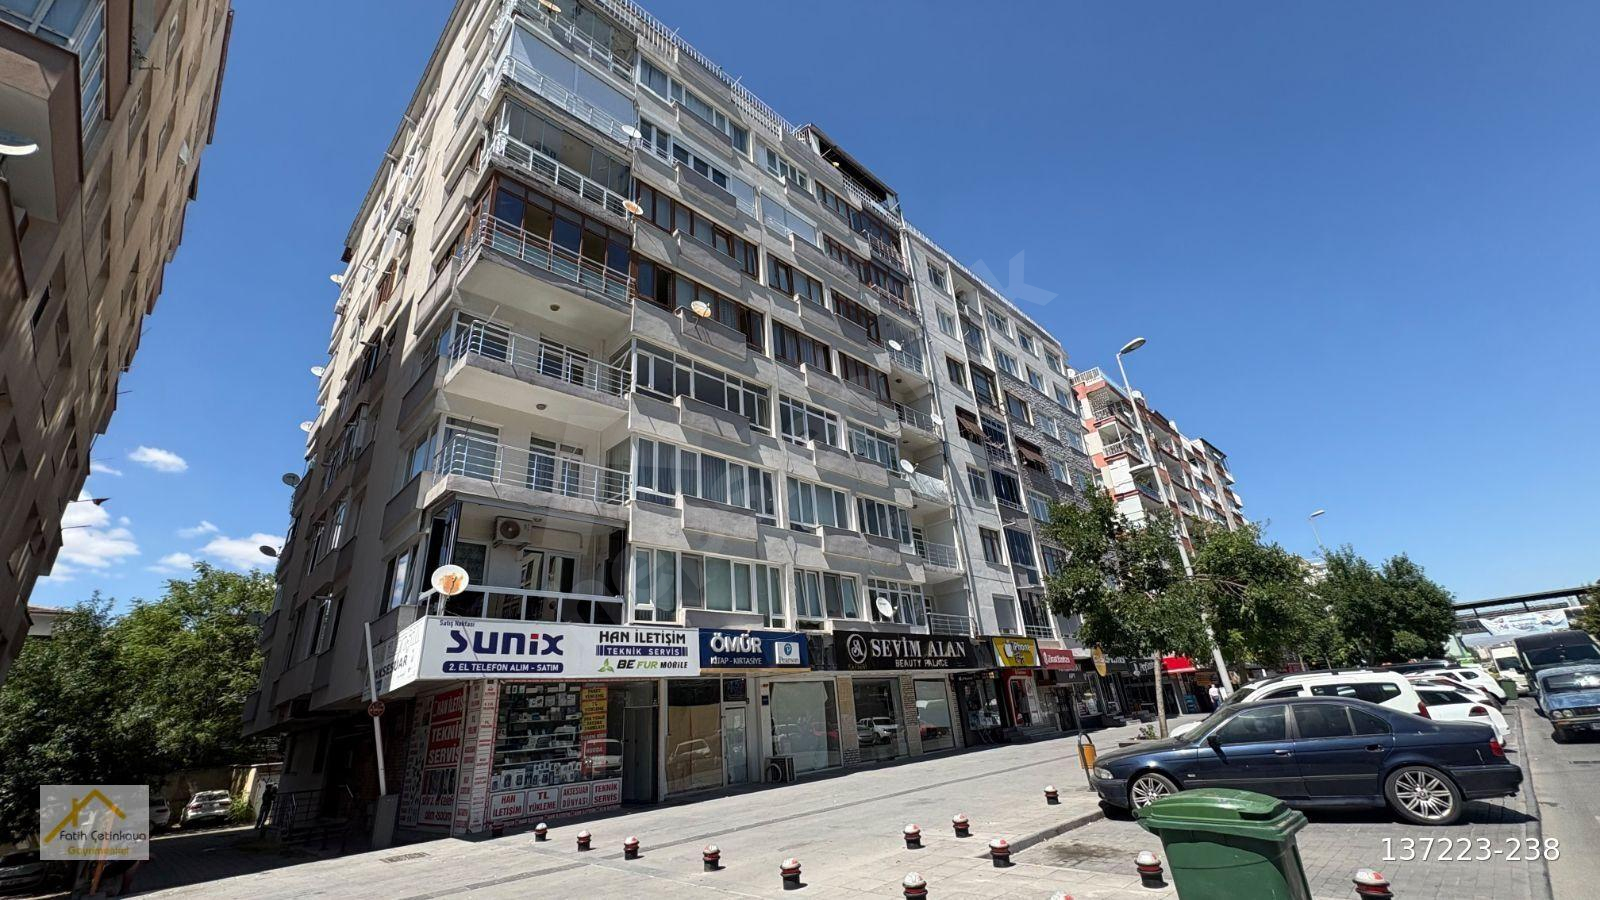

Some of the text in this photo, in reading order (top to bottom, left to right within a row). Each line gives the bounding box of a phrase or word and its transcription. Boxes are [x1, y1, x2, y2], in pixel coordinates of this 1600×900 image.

[599, 629, 686, 646] HAN İLETİŞİM
[710, 632, 762, 653] ÖMÜR
[606, 646, 680, 655] TEKNİK SERVİS
[870, 636, 966, 657] SEVİM ALAN
[458, 663, 468, 672] EL
[469, 663, 504, 672] TELEFON
[506, 664, 528, 672] ALIM
[537, 664, 560, 673] SATIM
[895, 658, 949, 668] BEAUTY PALACE
[562, 785, 589, 796] AKSESUAR
[594, 781, 618, 793] TEKNİK
[501, 794, 516, 804] HAN
[537, 791, 550, 799] TL
[593, 793, 618, 804] SERVİS
[493, 805, 522, 817] İLETİŞİM
[528, 800, 556, 812] YÜKLEME
